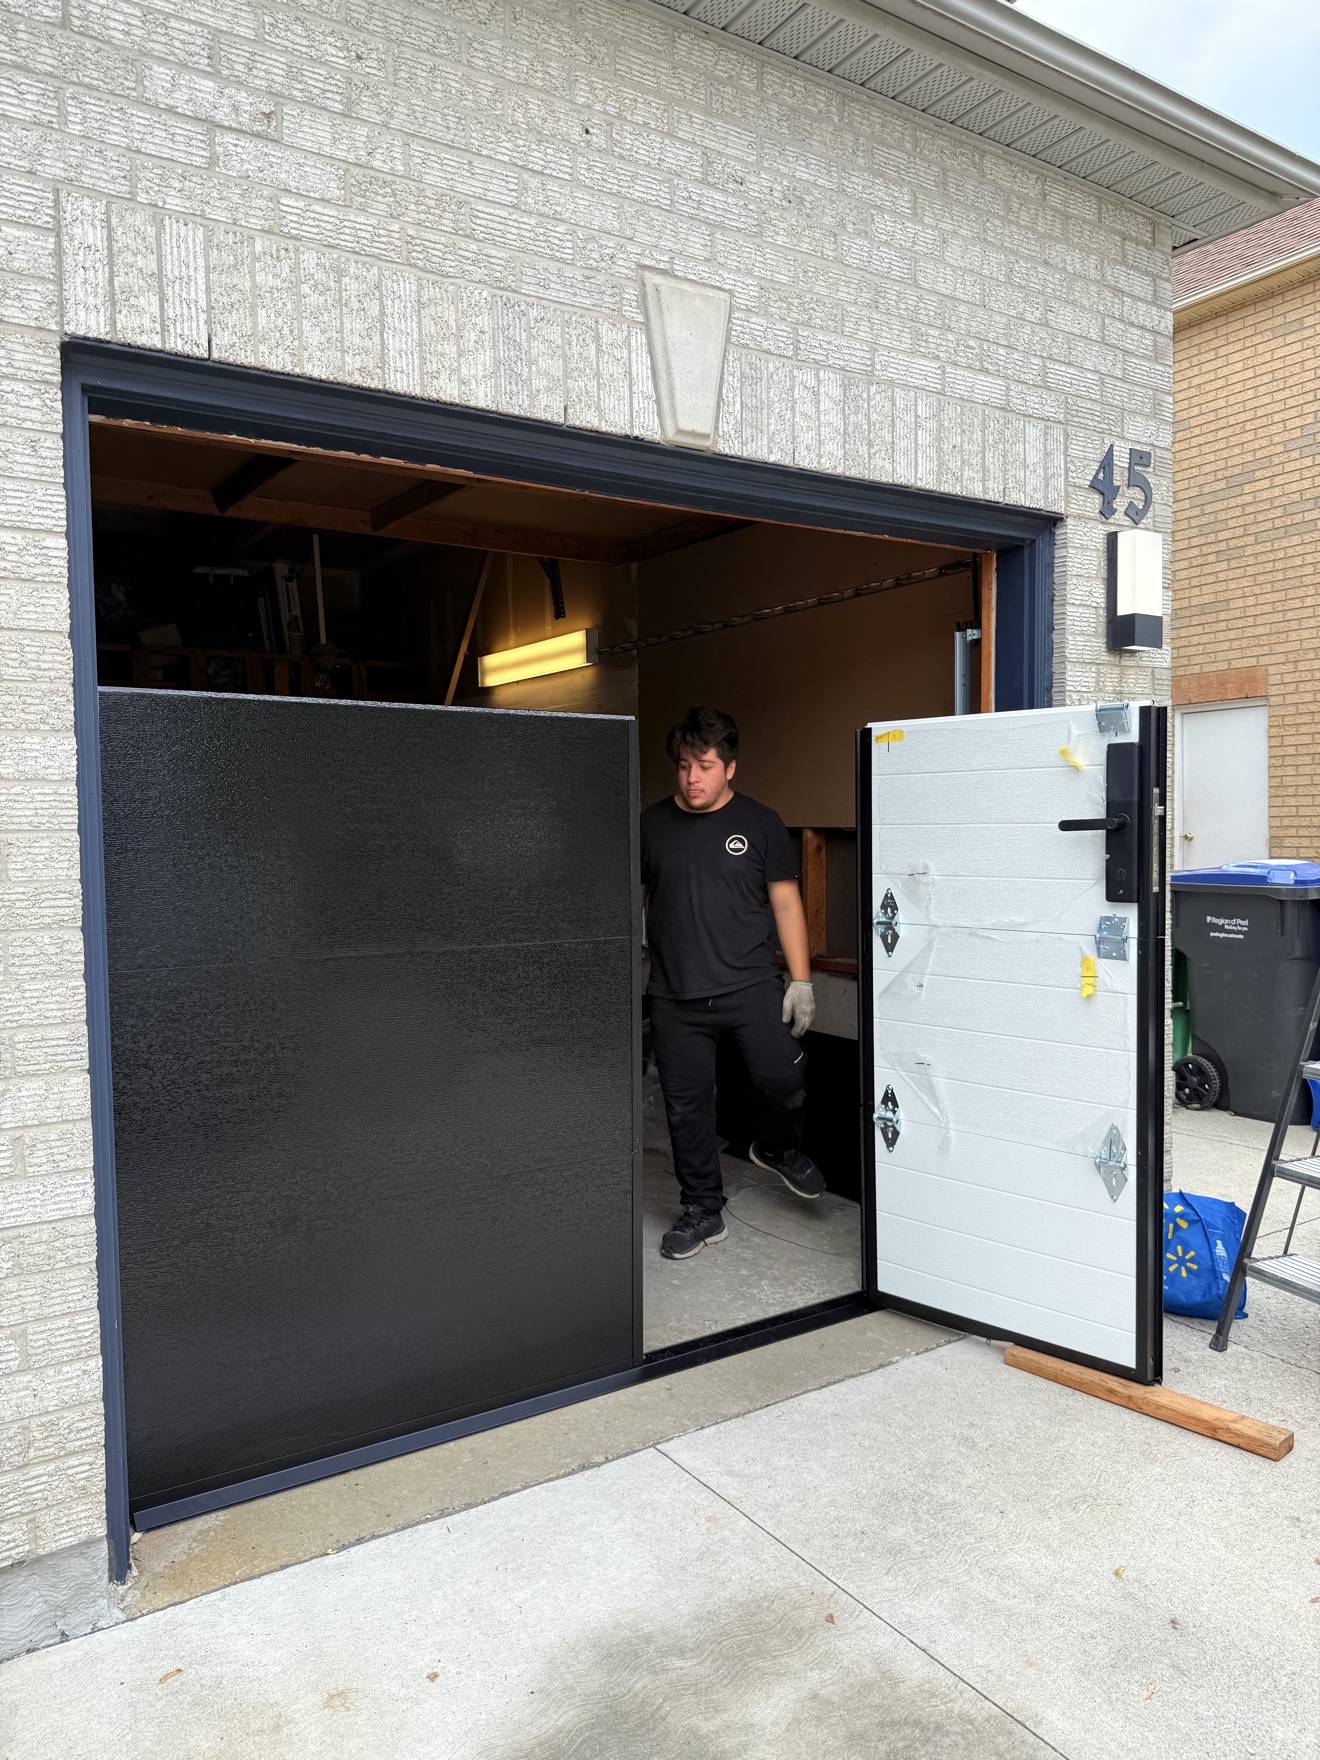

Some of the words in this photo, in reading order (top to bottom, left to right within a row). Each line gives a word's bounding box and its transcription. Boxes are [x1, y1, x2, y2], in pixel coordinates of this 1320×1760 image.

[1089, 444, 1152, 525] 45
[1211, 916, 1230, 926] Region
[1237, 918, 1249, 926] Peel
